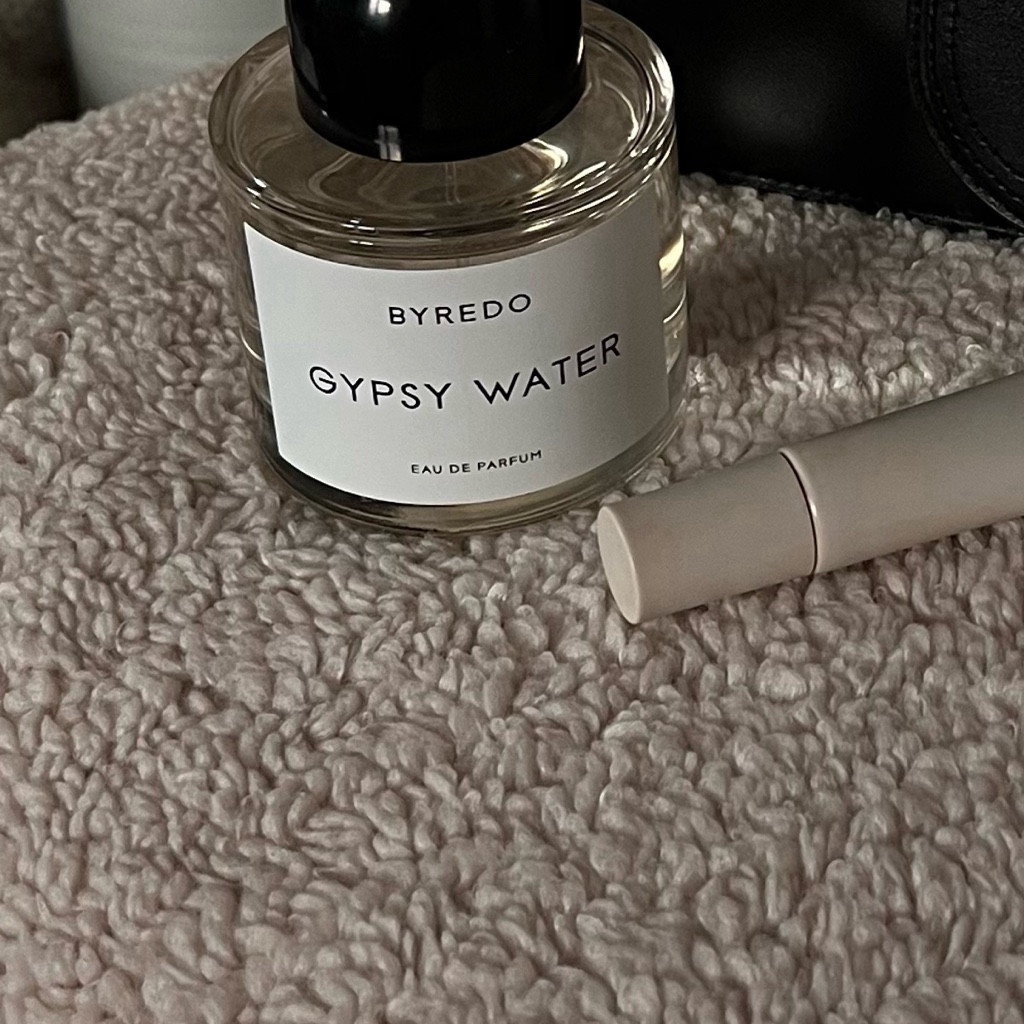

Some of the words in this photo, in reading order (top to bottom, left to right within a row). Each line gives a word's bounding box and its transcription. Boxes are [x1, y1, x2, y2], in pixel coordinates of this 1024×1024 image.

[388, 293, 532, 325] BYREDO
[309, 366, 452, 410] GYPSY
[474, 333, 621, 405] WATER
[411, 464, 443, 475] EAU
[449, 463, 471, 474] DE
[477, 450, 543, 471] PARFUM
